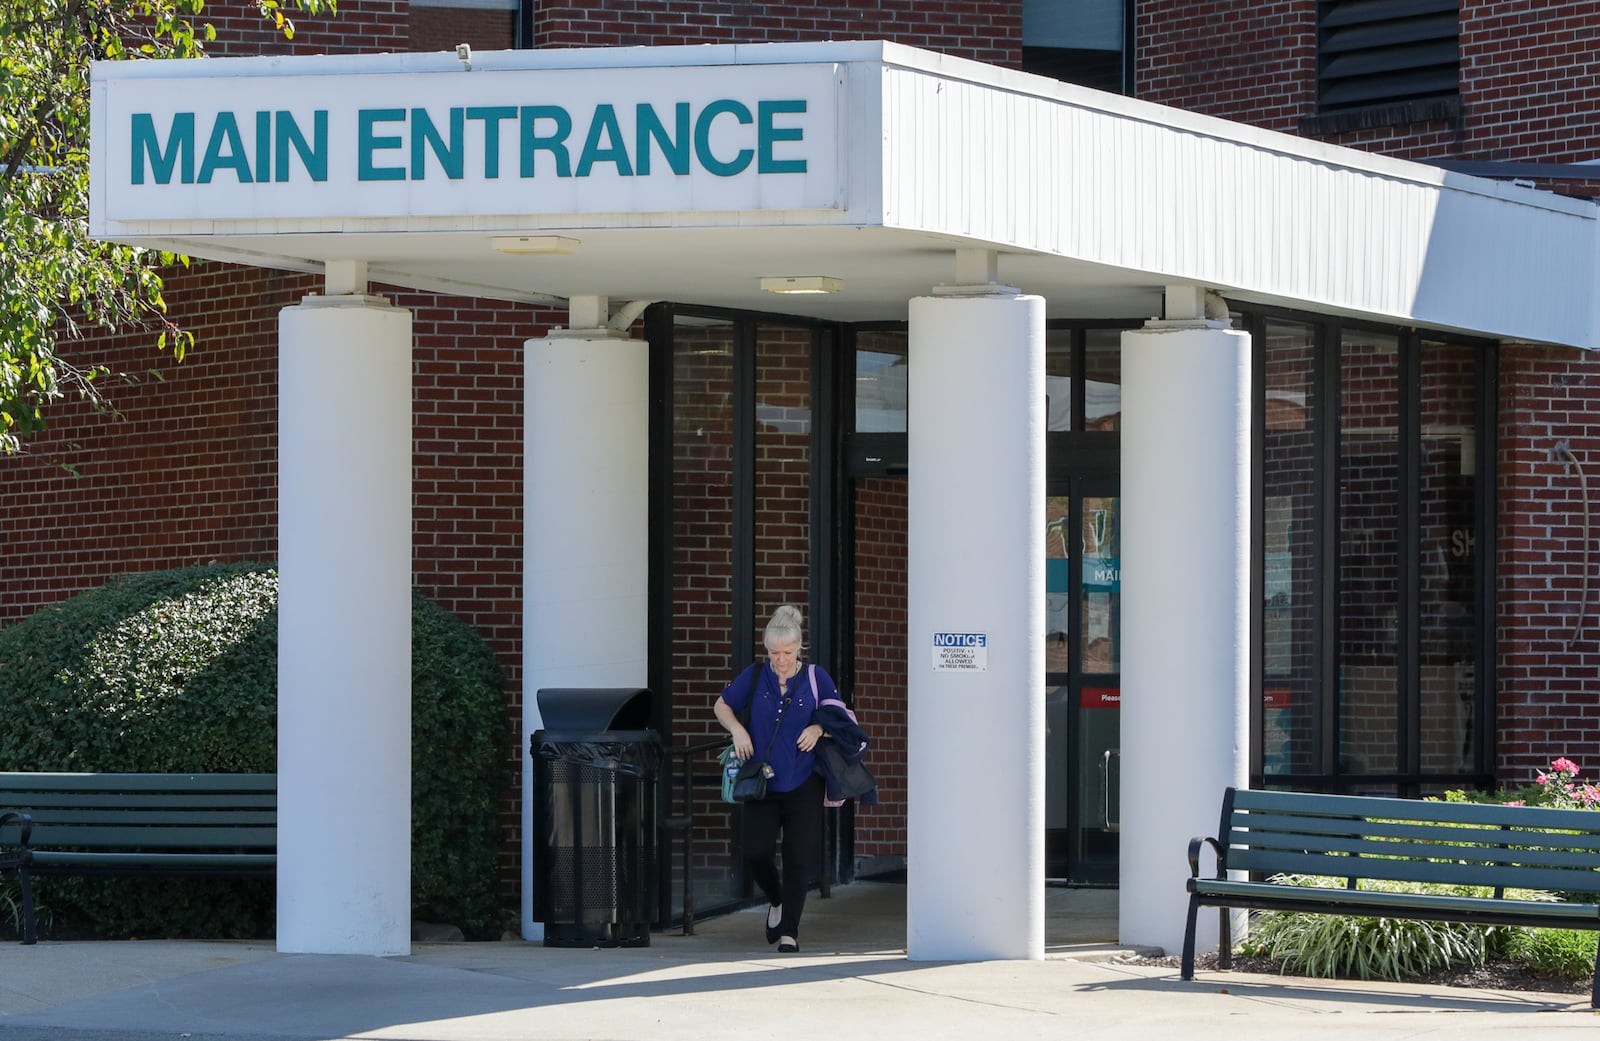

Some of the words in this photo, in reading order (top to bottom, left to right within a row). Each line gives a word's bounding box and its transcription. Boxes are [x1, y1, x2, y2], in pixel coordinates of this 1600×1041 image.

[131, 110, 329, 185] MAIN
[358, 99, 808, 181] ENTRANCE
[1095, 570, 1120, 581] MAI
[935, 634, 984, 646] NOTICE
